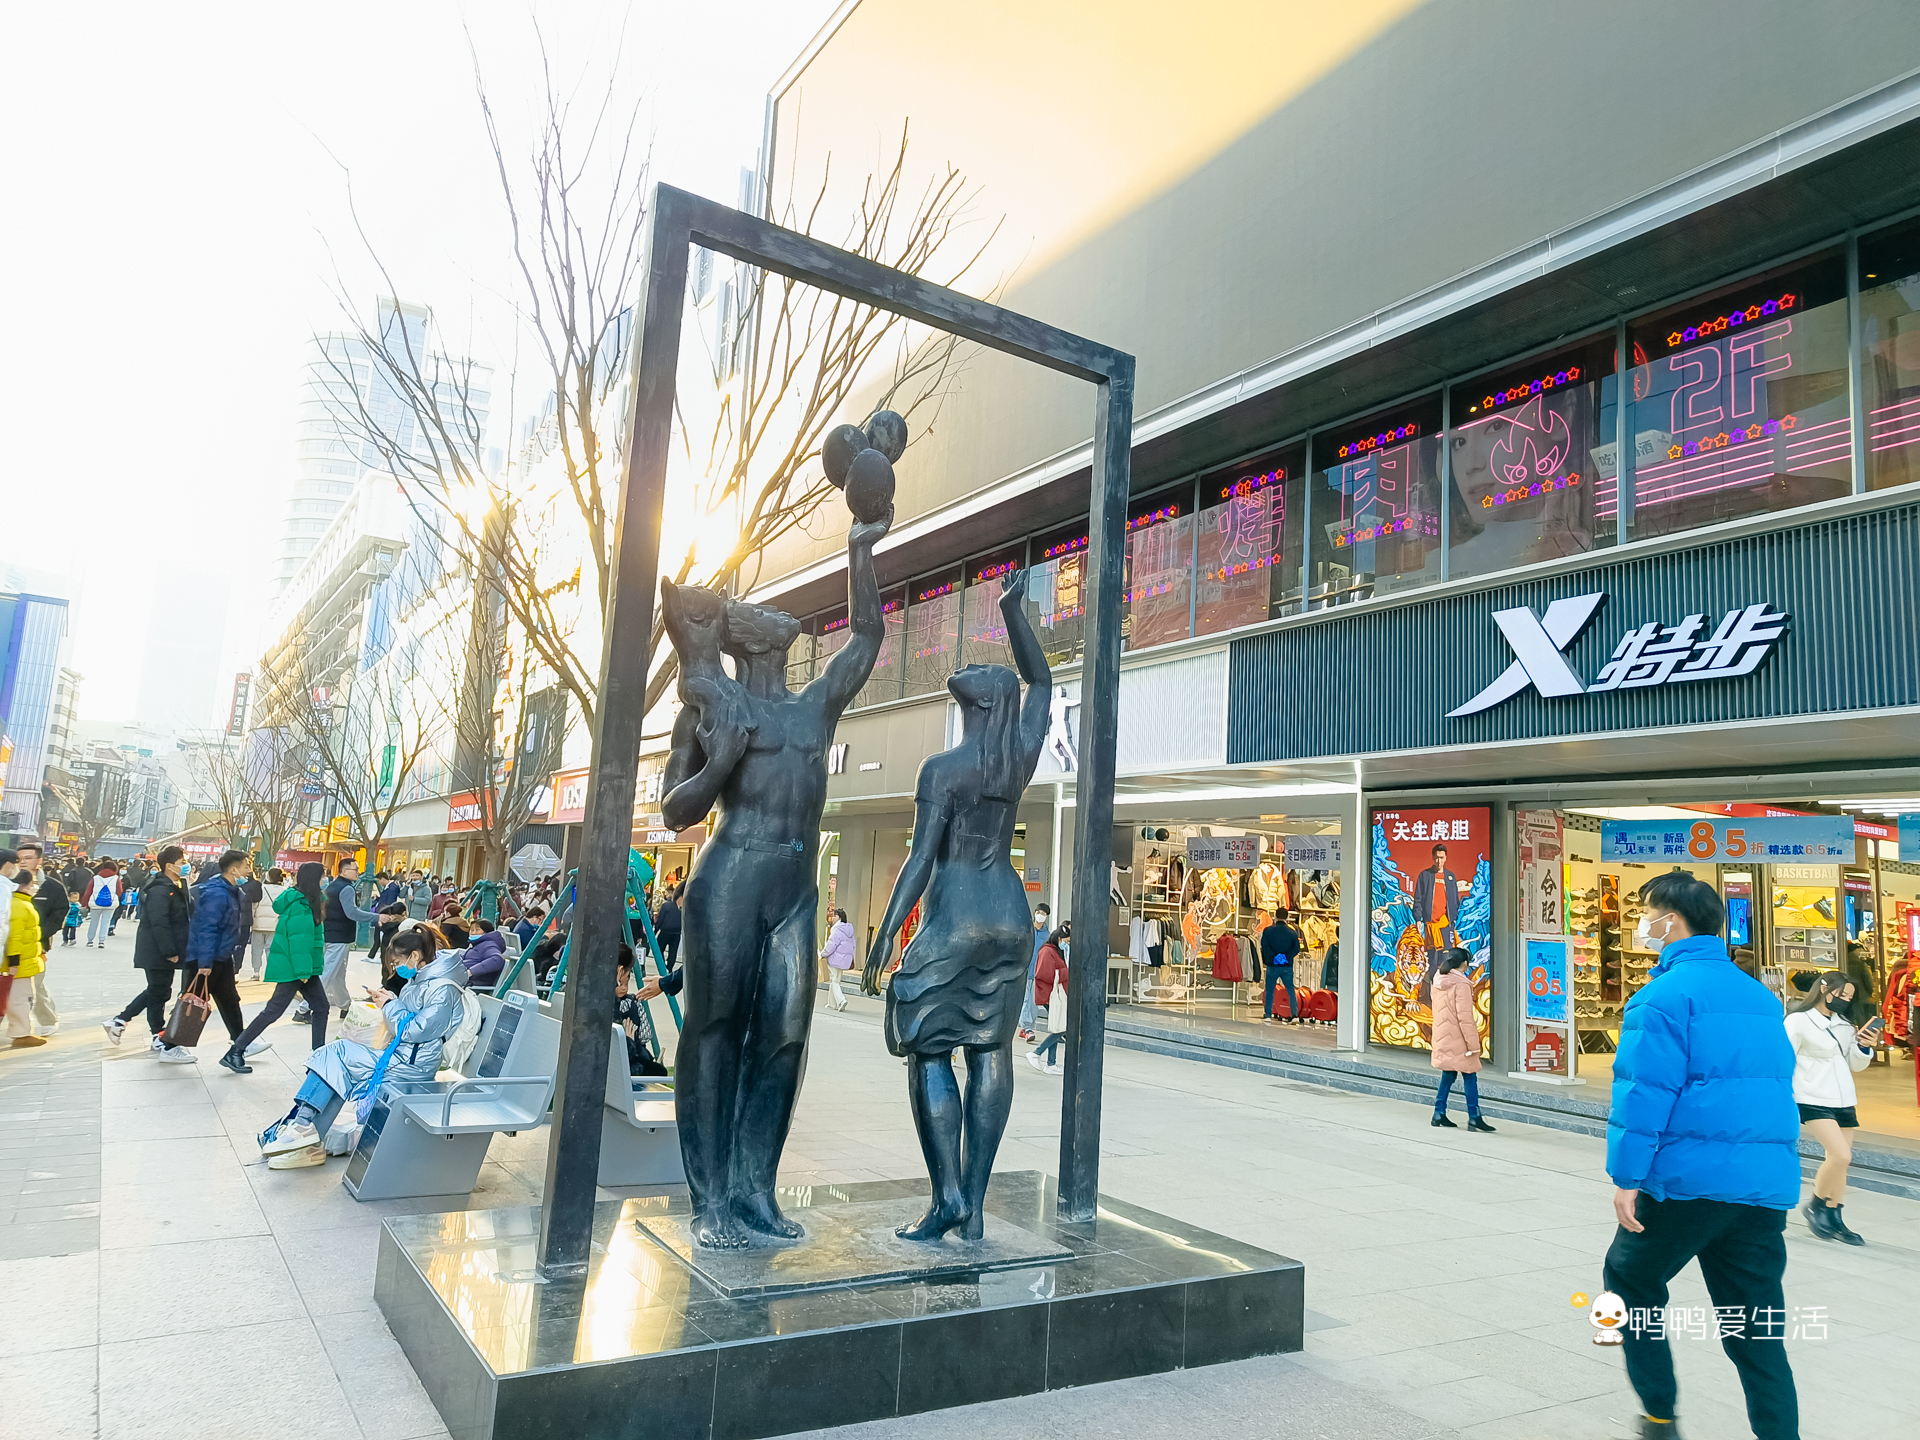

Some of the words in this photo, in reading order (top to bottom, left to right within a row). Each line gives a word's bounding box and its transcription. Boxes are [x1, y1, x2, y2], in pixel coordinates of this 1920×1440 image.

[1669, 318, 1792, 435] 2F
[1340, 443, 1410, 532] 肉
[1586, 602, 1788, 693] 特步
[1391, 819, 1470, 842] 天生虎胆
[1663, 832, 1685, 844] 新品
[1663, 844, 1685, 856] 两件
[1540, 868, 1558, 925] 合肥
